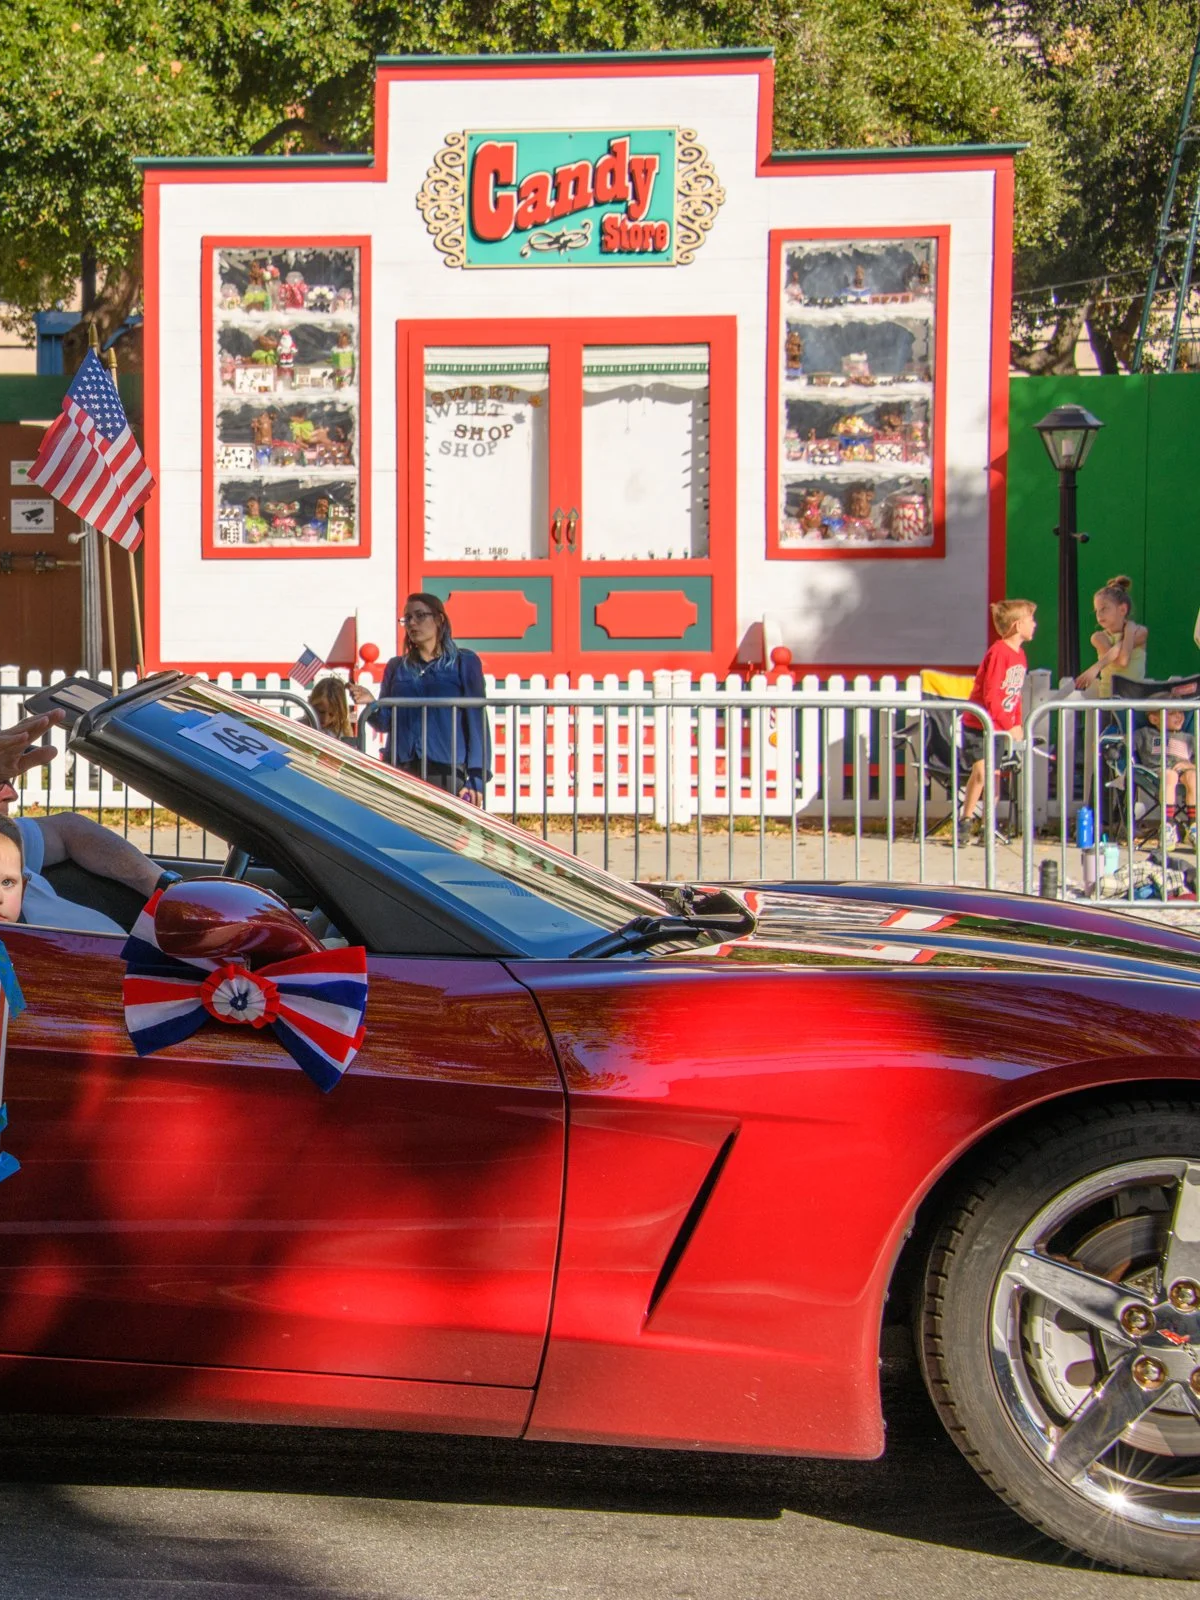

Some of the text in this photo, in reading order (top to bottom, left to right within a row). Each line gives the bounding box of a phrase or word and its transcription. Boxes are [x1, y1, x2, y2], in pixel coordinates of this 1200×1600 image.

[472, 136, 660, 243] Candy
[601, 212, 671, 255] Store
[431, 385, 520, 406] SWEET
[453, 423, 514, 442] SHOP
[211, 727, 270, 756] 46
